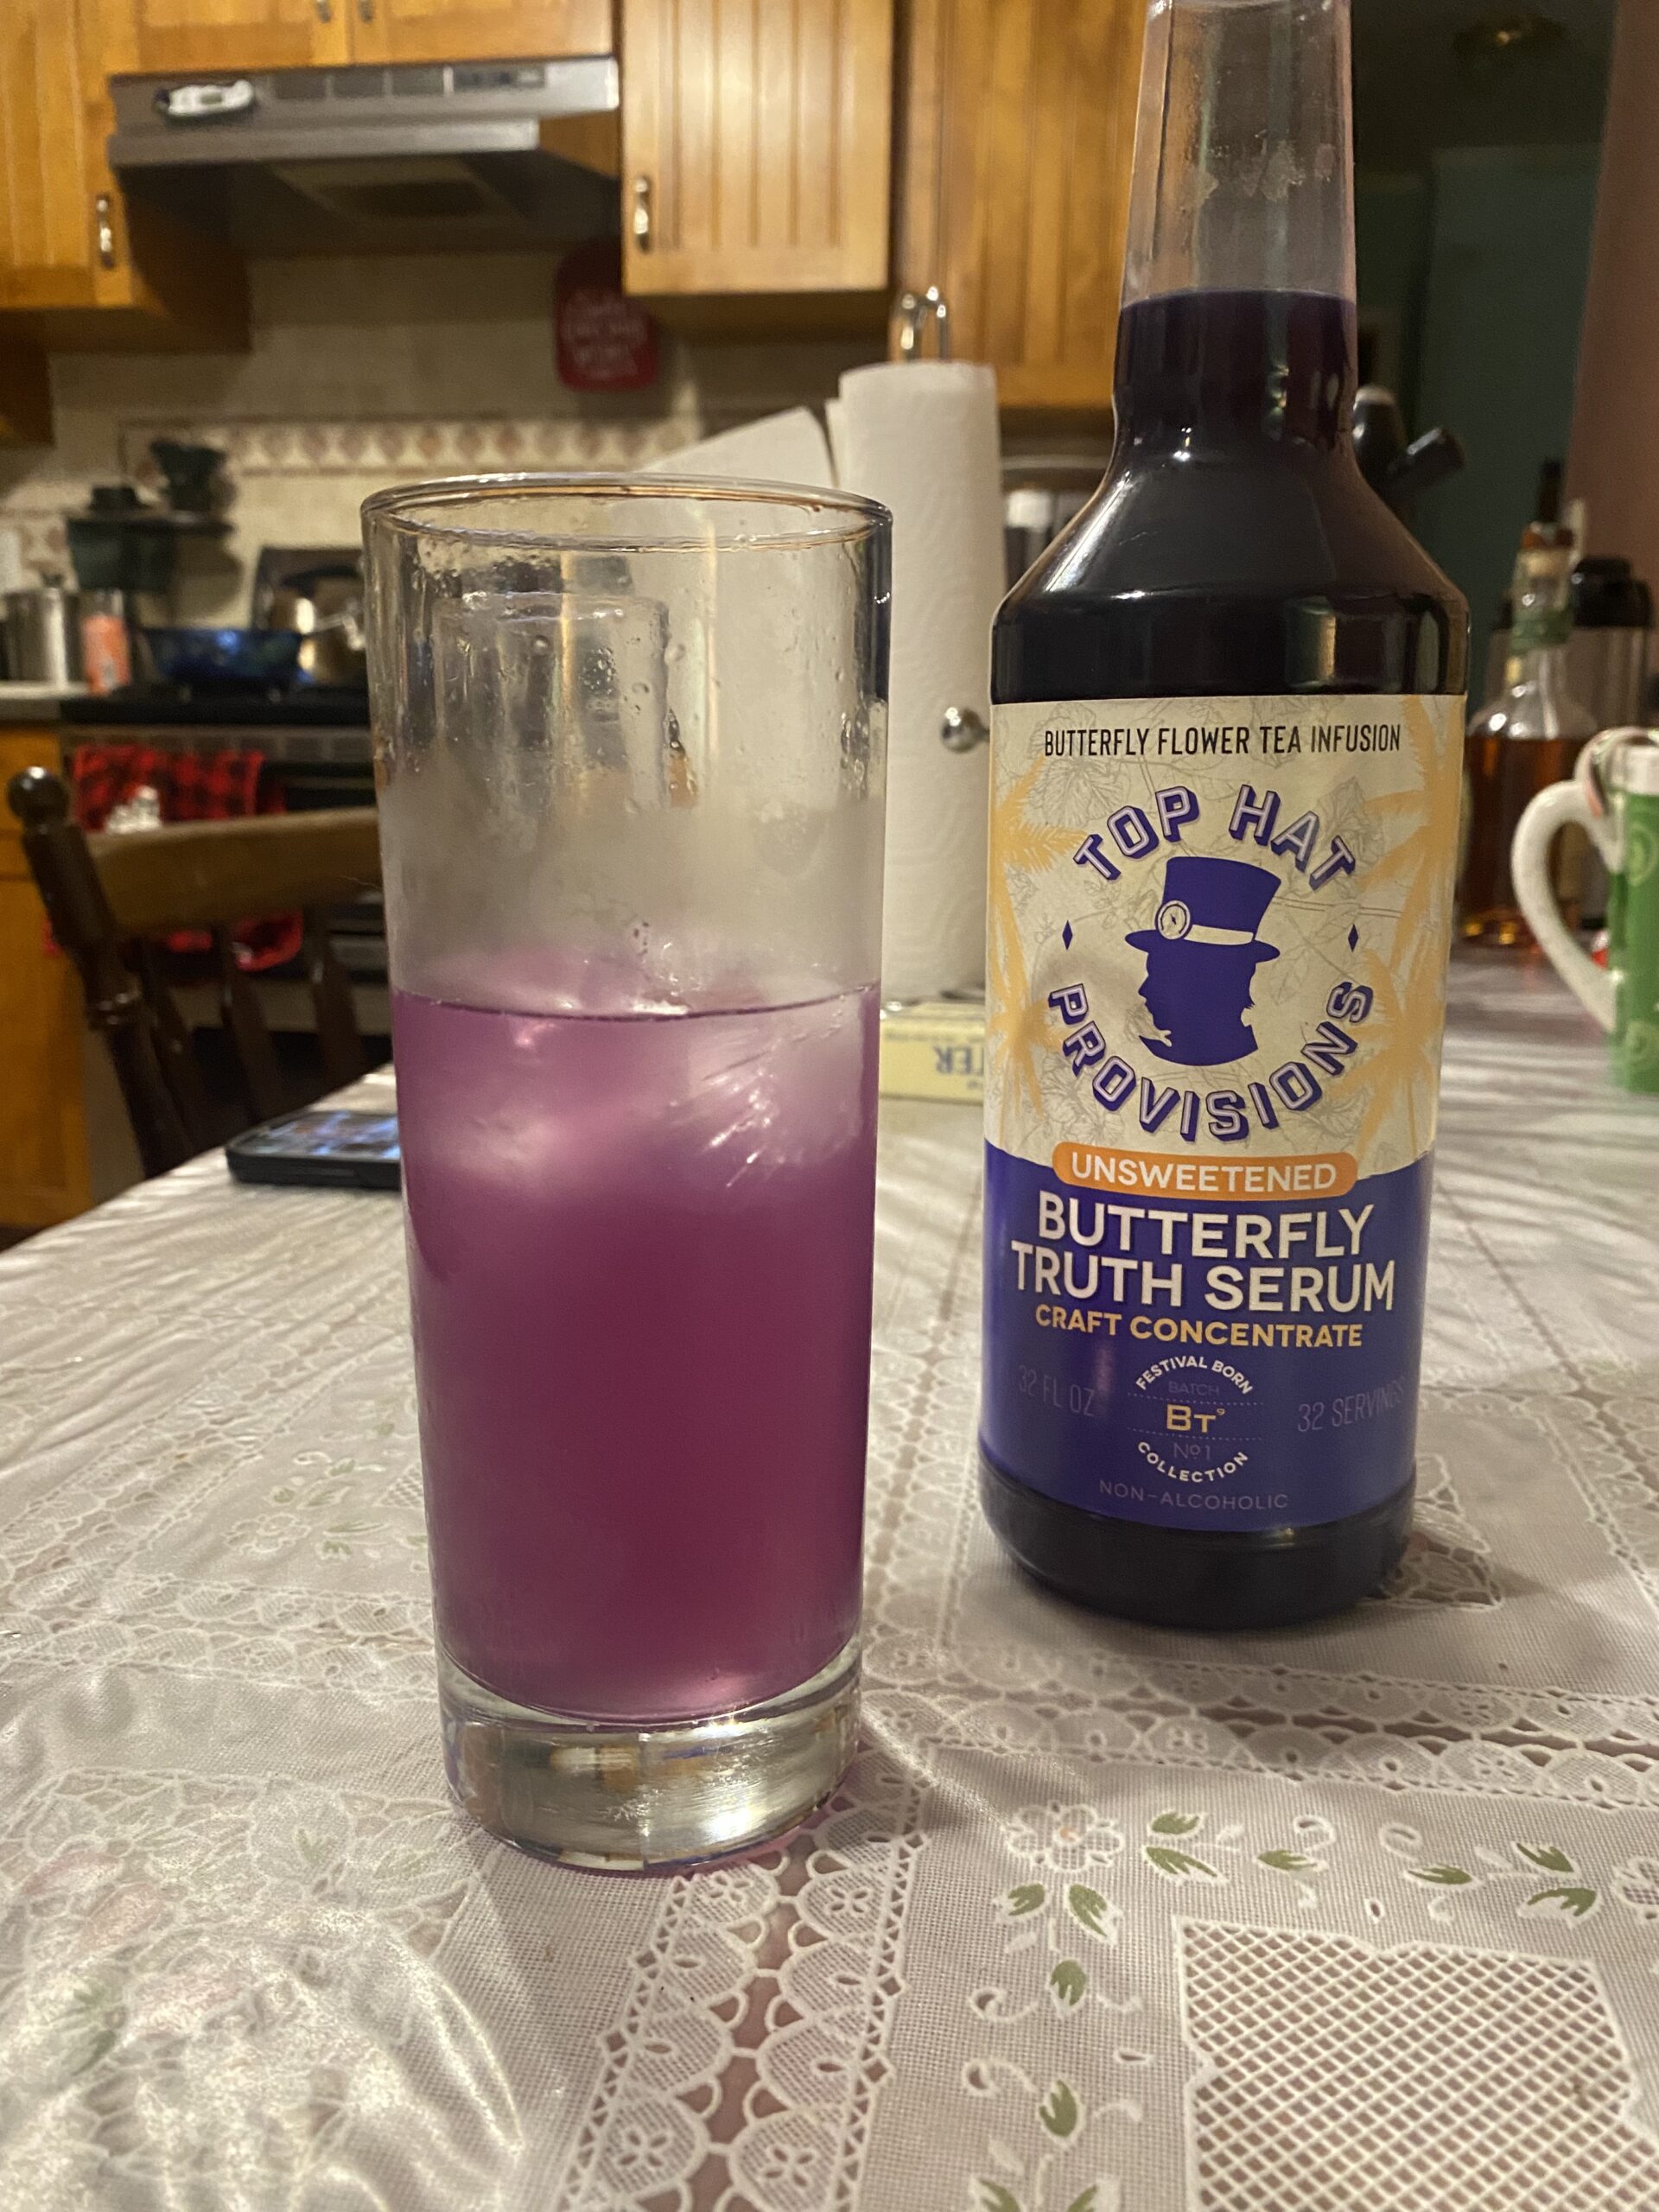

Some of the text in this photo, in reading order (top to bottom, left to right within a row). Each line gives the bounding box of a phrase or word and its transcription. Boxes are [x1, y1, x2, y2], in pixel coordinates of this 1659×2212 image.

[1045, 724, 1401, 756] BUTTERFLY FLOWER TEA INFUSION
[1073, 785, 1356, 891] TOP HAT
[1048, 982, 1374, 1142] PROVISIONS
[1071, 1152, 1336, 1192] UNSWEETENED
[1039, 1191, 1375, 1259] BUTTERFLY
[1011, 1240, 1395, 1313] TRUTH SERUM
[1036, 1304, 1363, 1348] CRAFT CONCENTRATE
[1019, 1364, 1096, 1417] 32 FL OZ
[1135, 1356, 1253, 1395] FESTIVAL BORN
[1168, 1382, 1219, 1396] BATCH
[1298, 1402, 1325, 1433] 32
[1138, 1441, 1249, 1483] COLLECTION
[1099, 1480, 1288, 1510] NON-ALCOHOLIC
